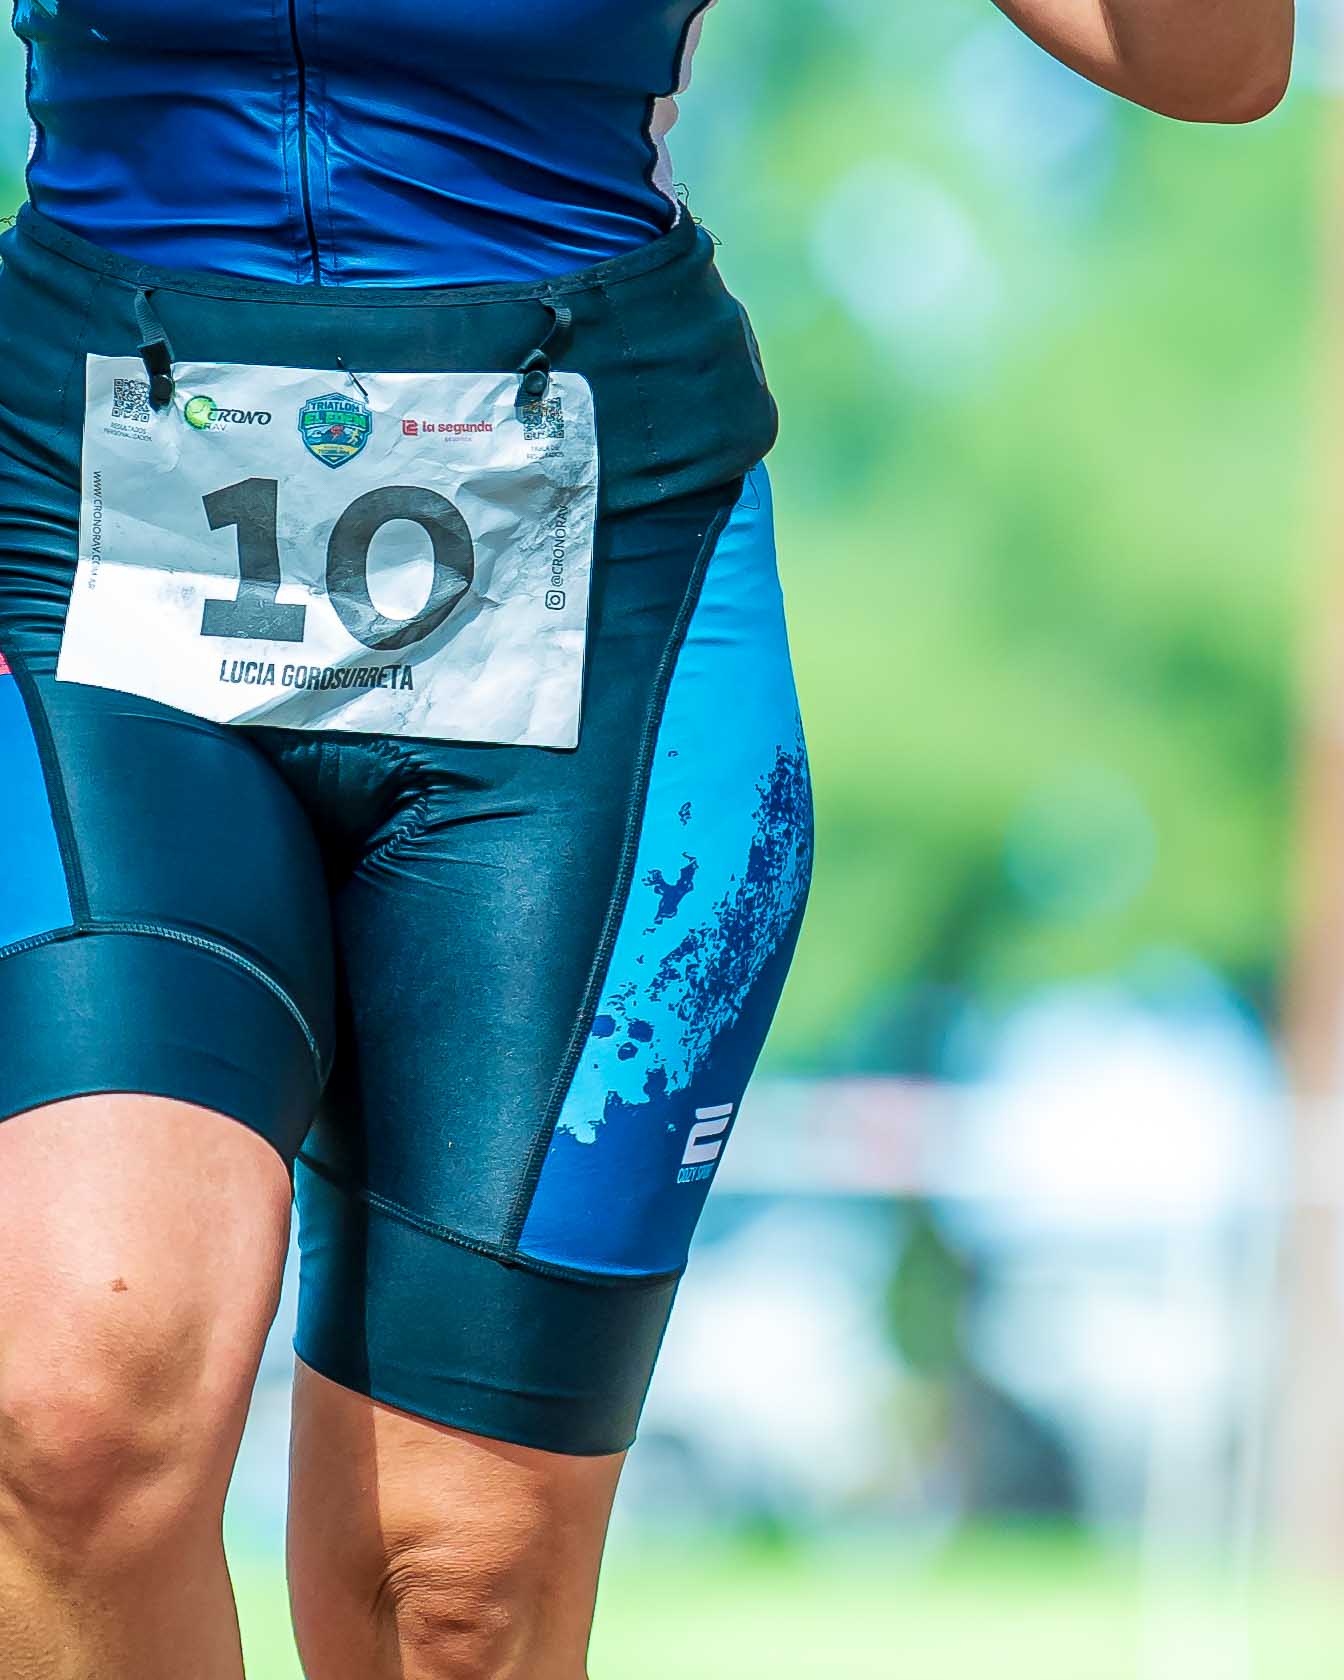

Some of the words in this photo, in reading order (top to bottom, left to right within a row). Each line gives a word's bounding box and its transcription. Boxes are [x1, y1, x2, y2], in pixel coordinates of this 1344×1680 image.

[206, 408, 272, 425] CRONO
[422, 421, 435, 432] la
[438, 421, 493, 435] segunda
[551, 504, 569, 588] @CRONORAV
[201, 477, 475, 651] 10
[219, 659, 276, 686] LUCIA
[281, 664, 414, 691] GOROSURRETA
